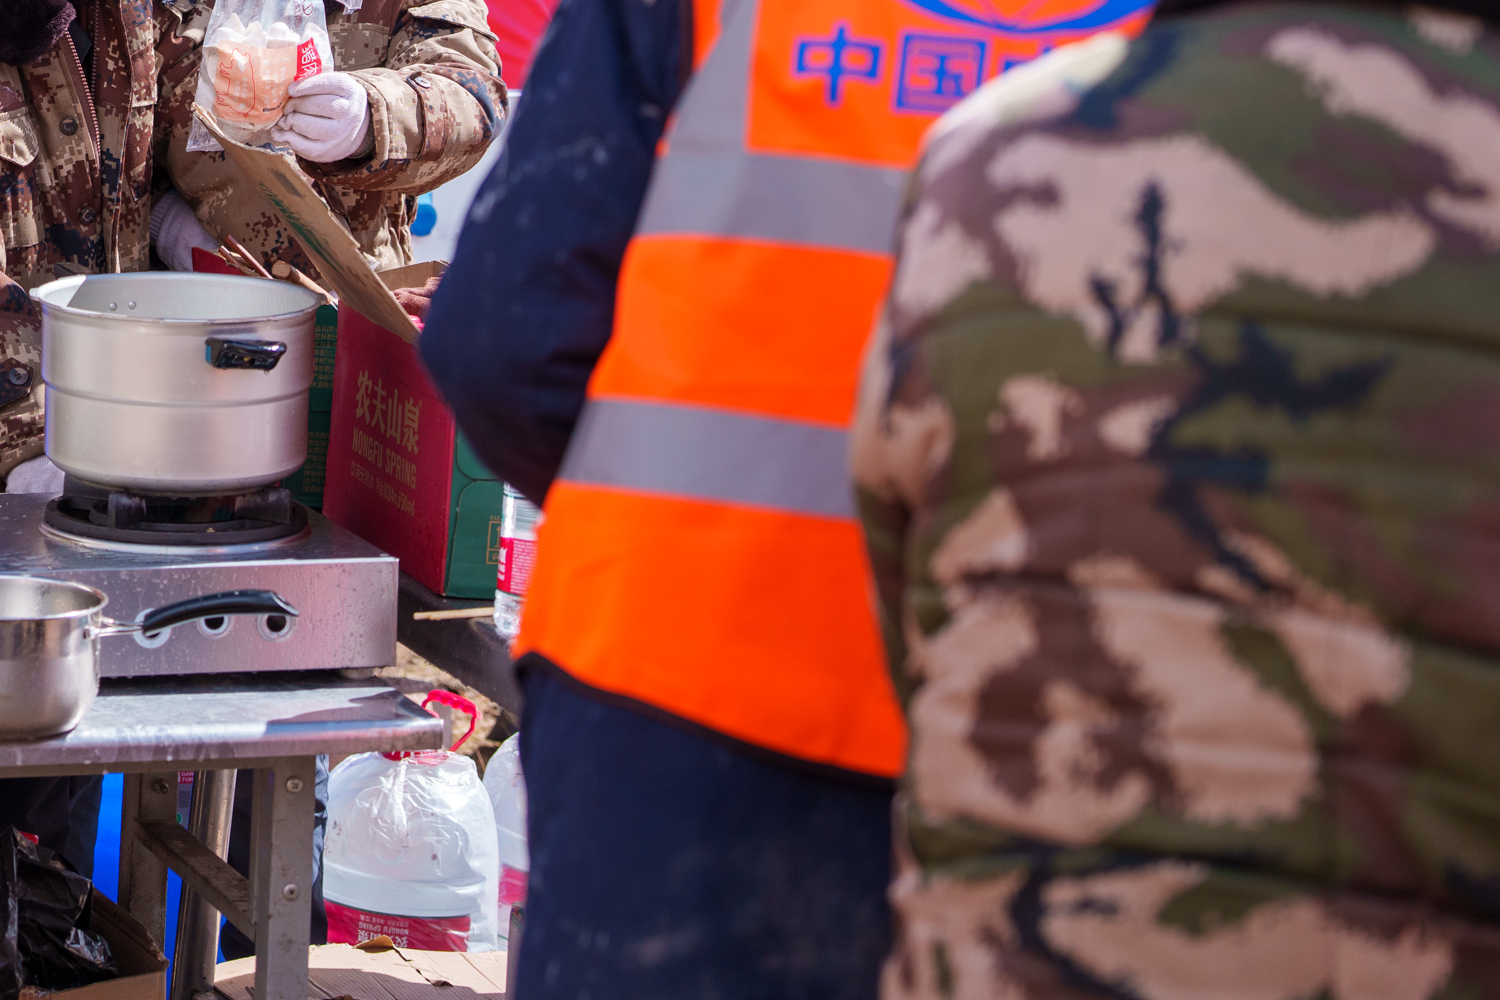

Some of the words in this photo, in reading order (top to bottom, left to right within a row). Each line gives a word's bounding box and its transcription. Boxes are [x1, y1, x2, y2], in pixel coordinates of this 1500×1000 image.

[797, 22, 1052, 113] 中国
[356, 369, 419, 455] 农夫山泉
[352, 426, 383, 468] NONGFU
[385, 448, 417, 489] SPRING
[358, 921, 382, 931] SPRING
[383, 925, 409, 935] NONGFU
